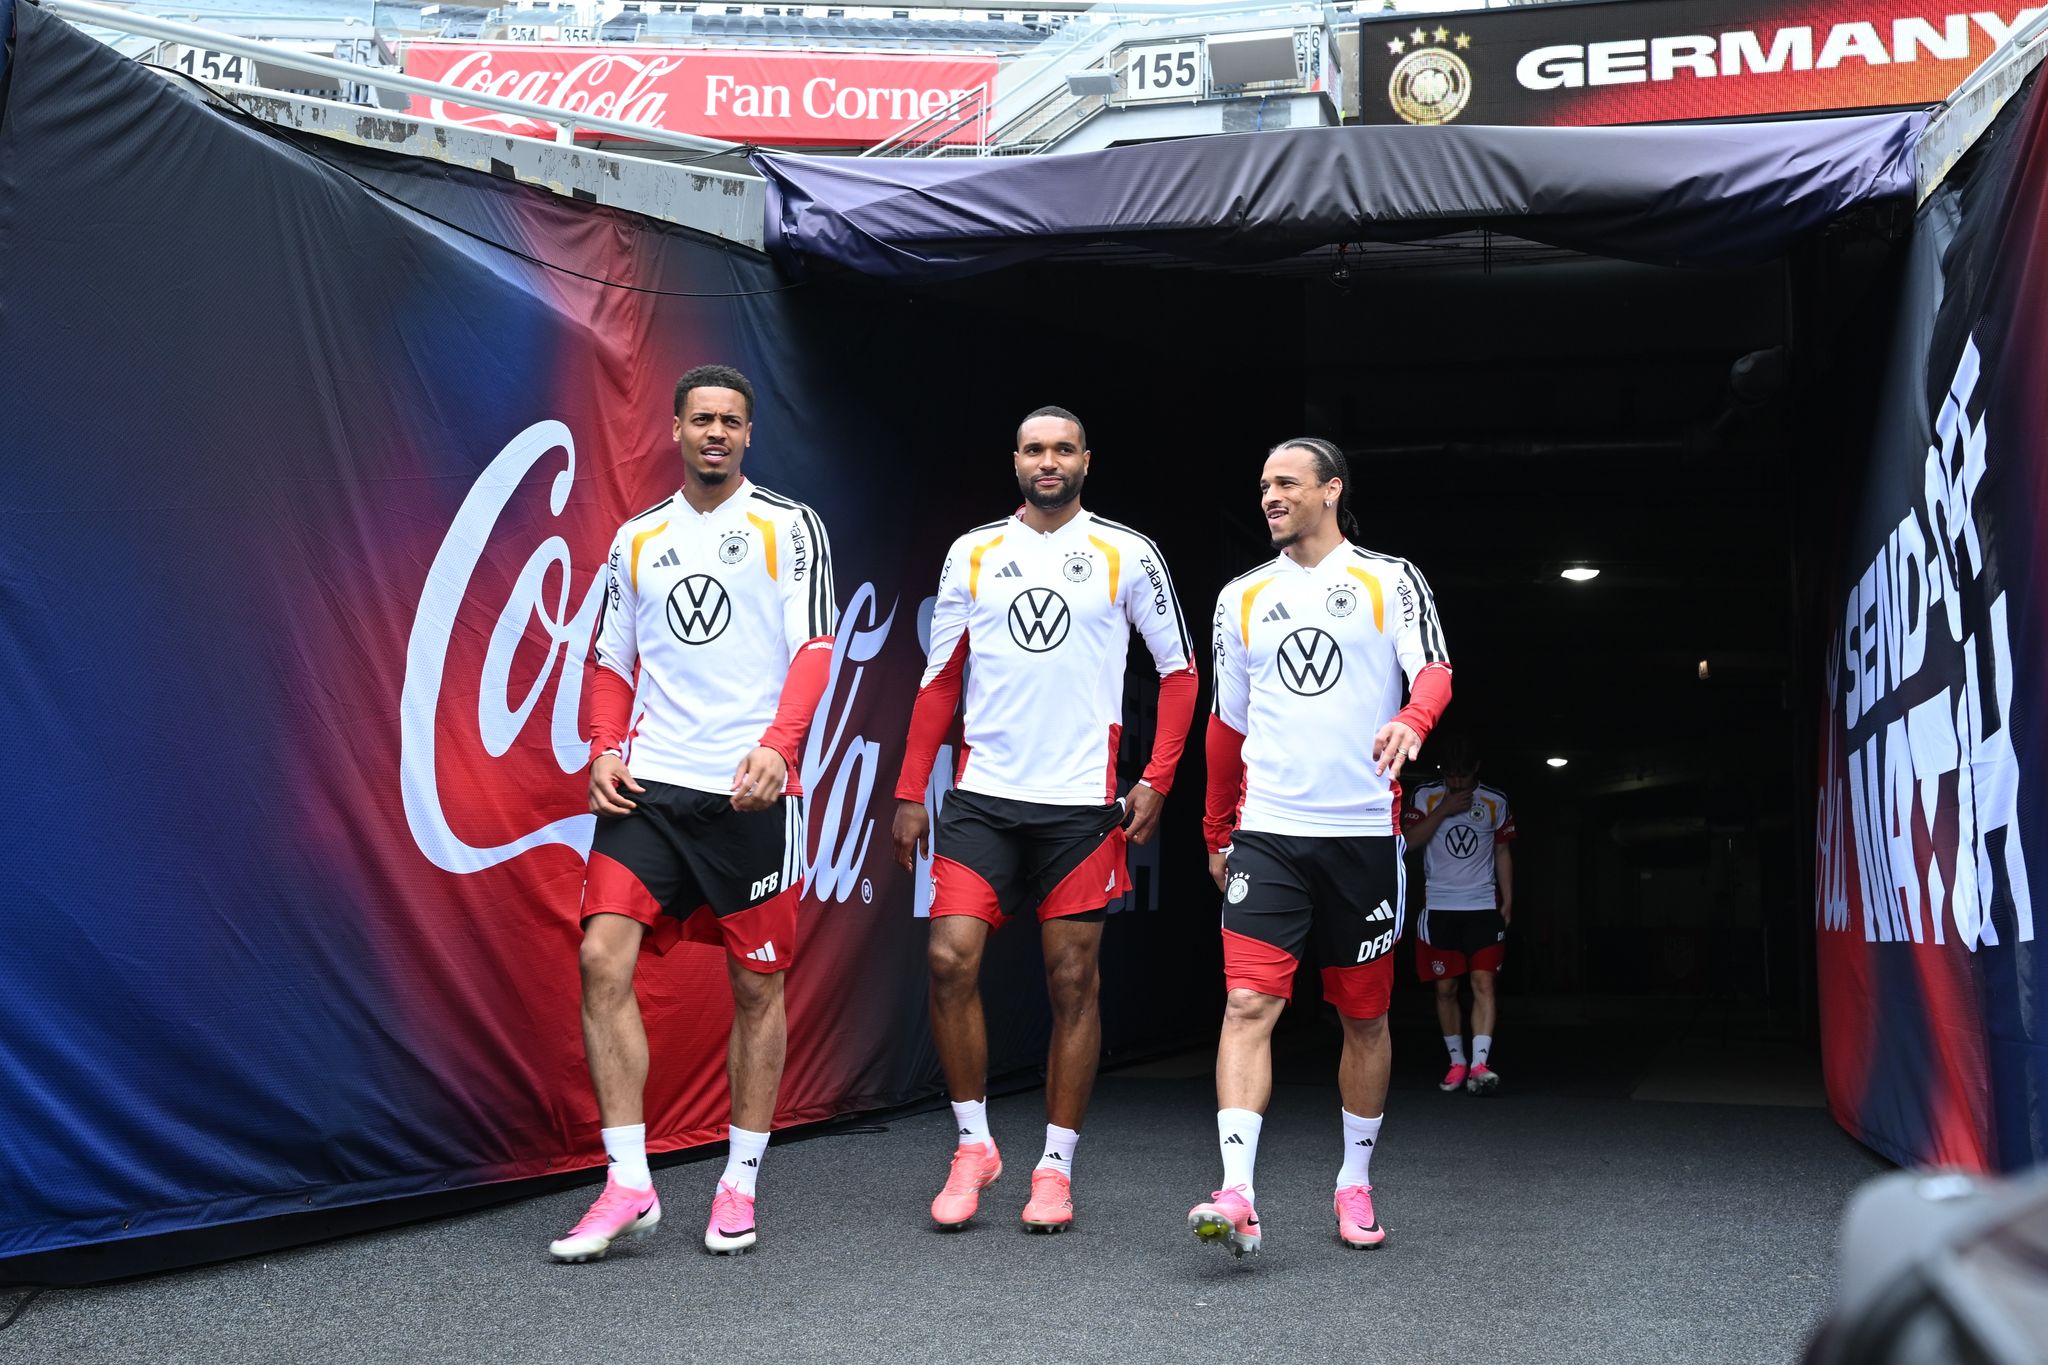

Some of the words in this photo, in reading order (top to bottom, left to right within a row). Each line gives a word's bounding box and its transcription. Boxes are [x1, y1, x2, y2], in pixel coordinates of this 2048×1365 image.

[180, 49, 243, 84] 154
[1131, 51, 1196, 90] 155
[1516, 8, 2044, 91] GERMANY
[430, 51, 685, 130] Coca-Cola
[704, 75, 791, 118] Fan
[802, 77, 975, 121] Corner
[1140, 554, 1168, 616] zalando
[750, 871, 779, 901] DFB
[1357, 928, 1393, 963] DFB
